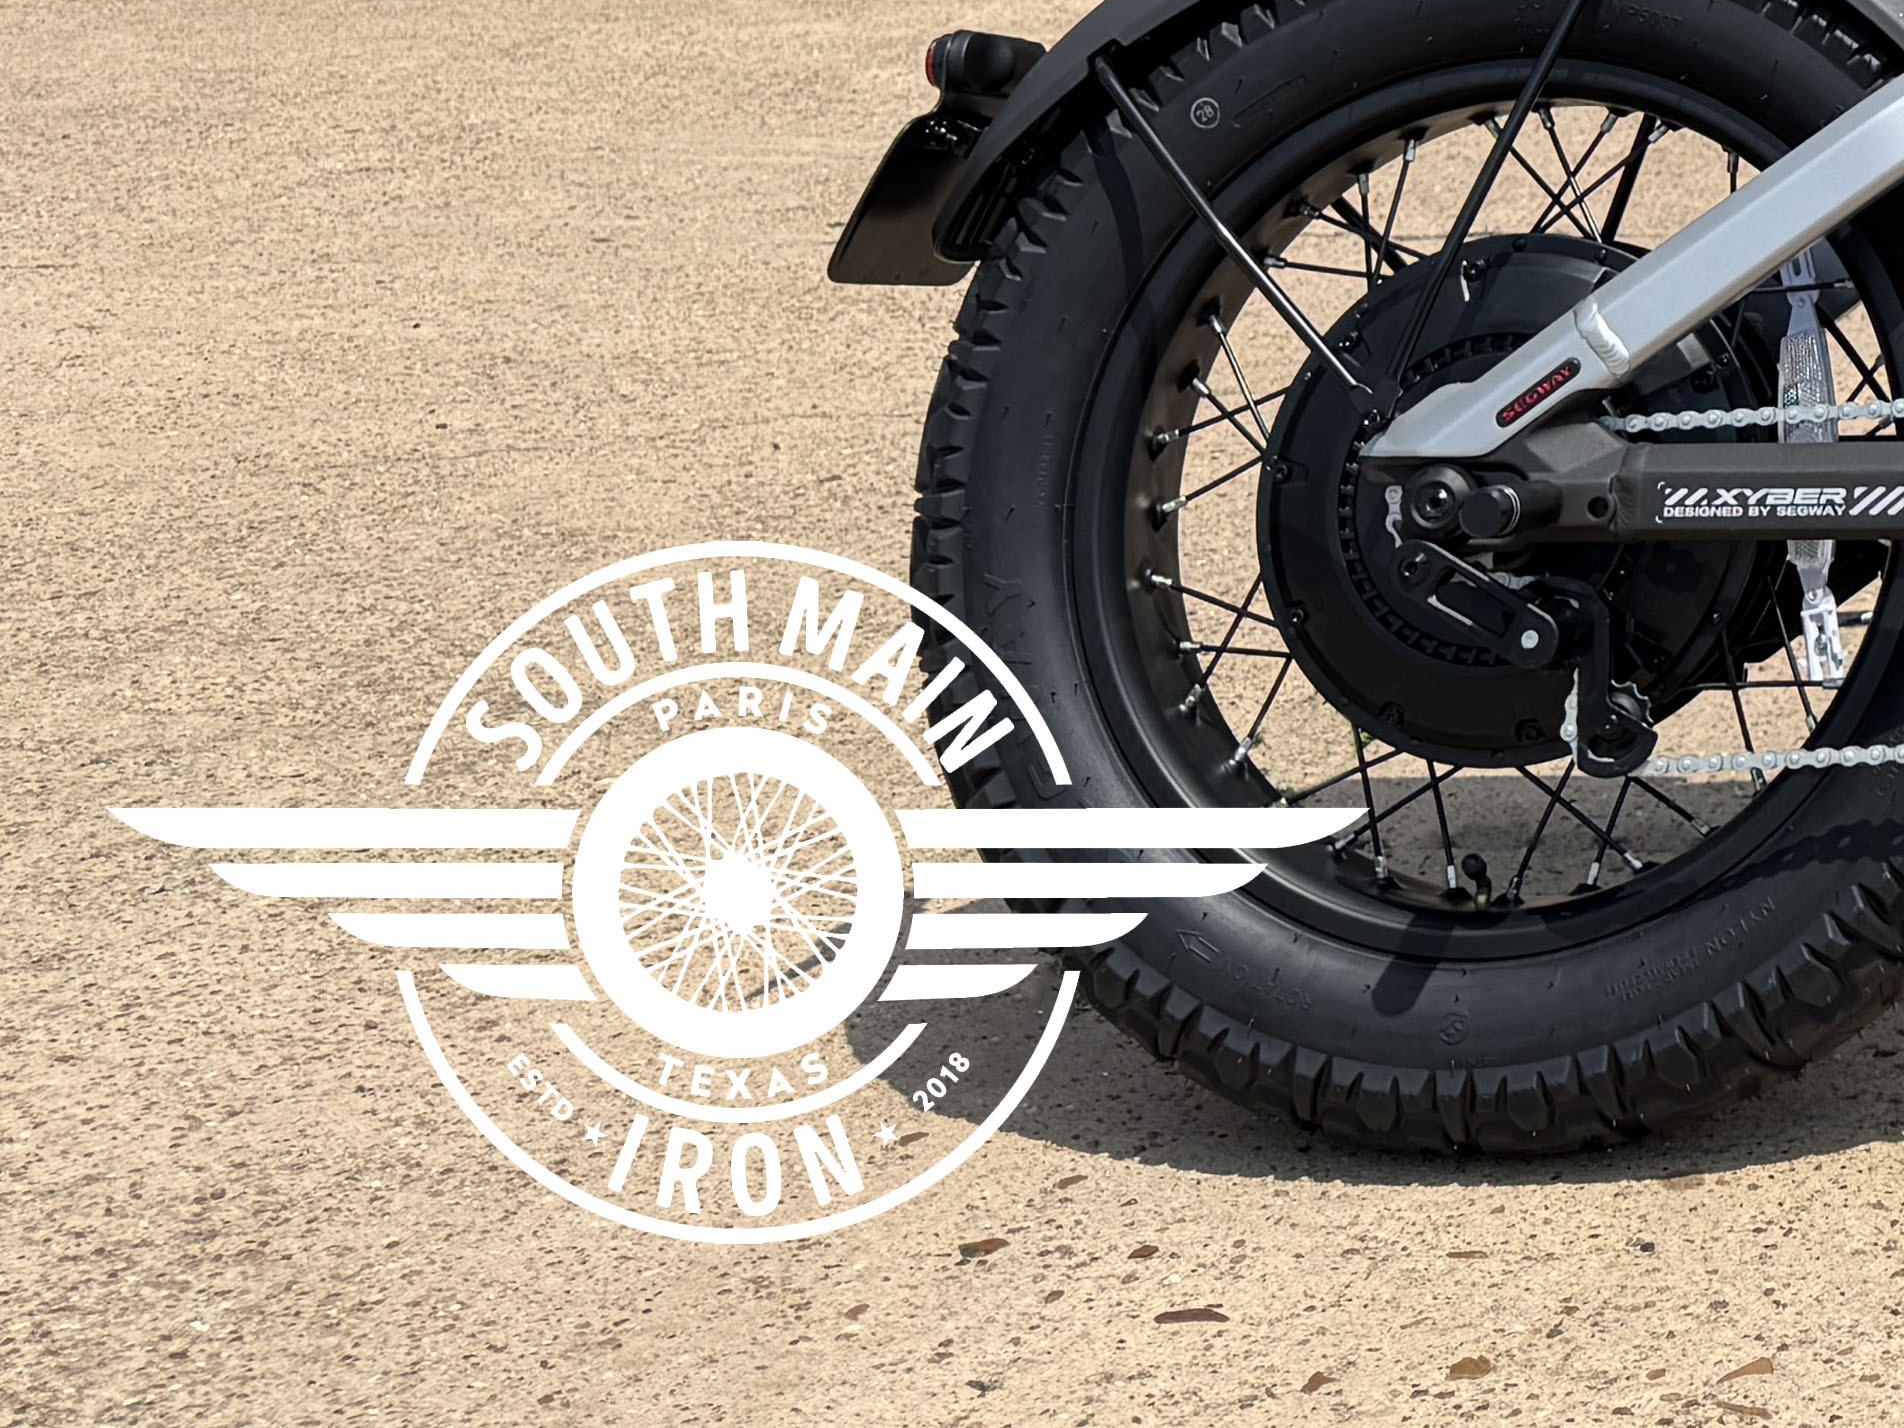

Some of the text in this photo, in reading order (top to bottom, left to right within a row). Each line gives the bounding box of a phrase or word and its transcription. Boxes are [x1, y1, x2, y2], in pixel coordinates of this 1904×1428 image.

[1195, 104, 1215, 123] 28
[1501, 365, 1572, 422] SEGWAY
[1711, 487, 1848, 506] XYBER
[1663, 504, 1847, 518] DESIGNED BY SEGWAY
